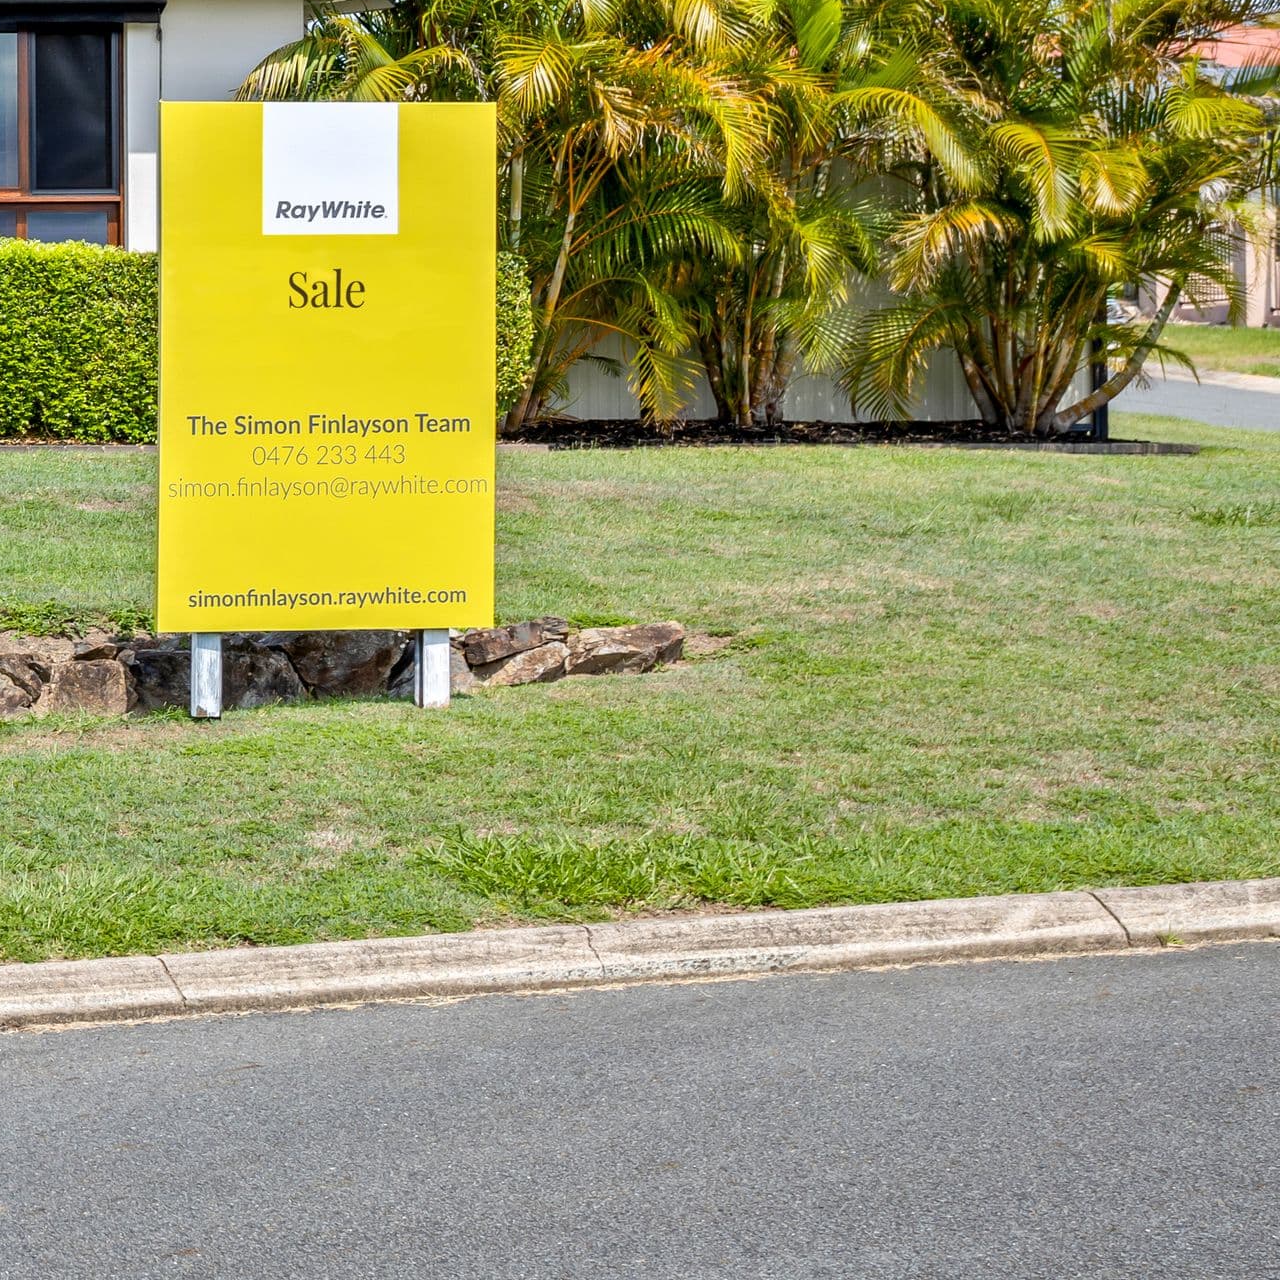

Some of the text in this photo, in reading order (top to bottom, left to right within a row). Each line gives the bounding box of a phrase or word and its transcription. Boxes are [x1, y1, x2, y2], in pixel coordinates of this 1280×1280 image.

[288, 268, 366, 309] Sale
[186, 413, 471, 438] The Simon Finlayson Team
[252, 444, 406, 466] 0476 233 443
[168, 475, 488, 501] simon.finlayson@raywhite.com
[188, 586, 467, 610] simonfinlayson.raywhite.com
